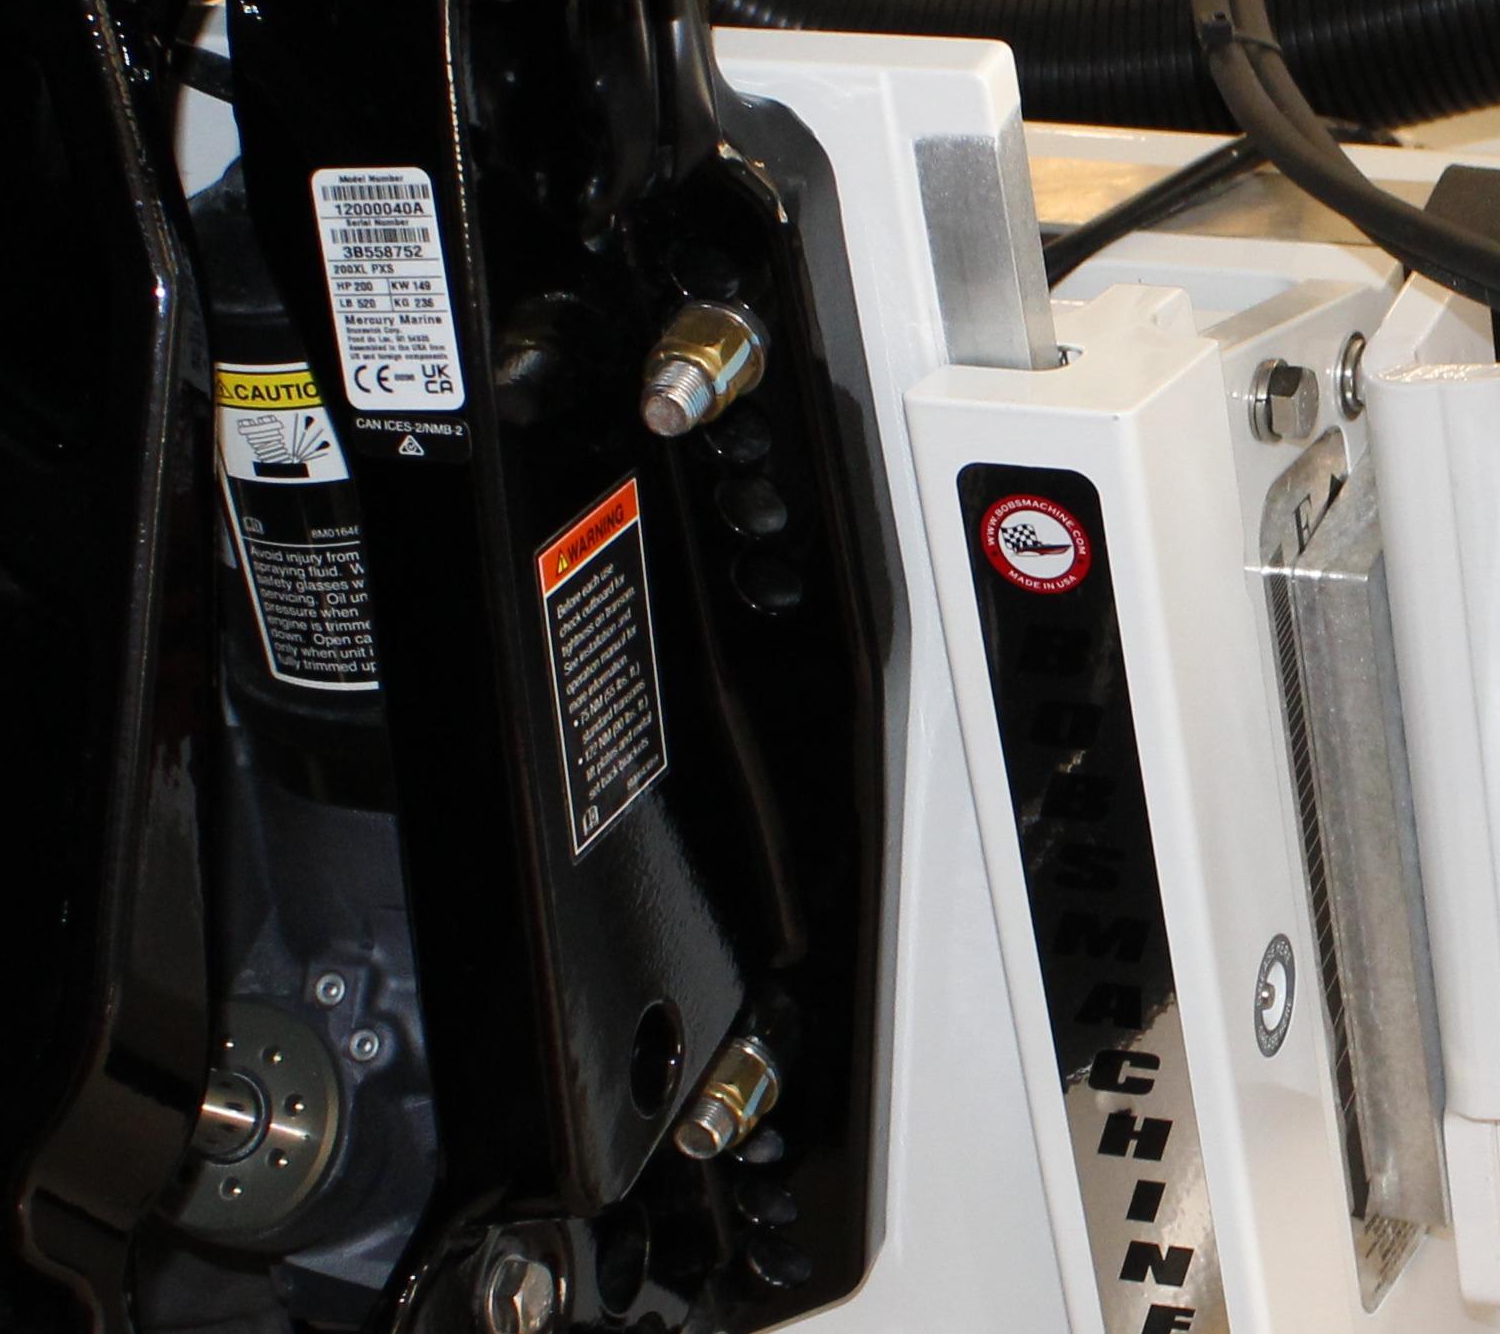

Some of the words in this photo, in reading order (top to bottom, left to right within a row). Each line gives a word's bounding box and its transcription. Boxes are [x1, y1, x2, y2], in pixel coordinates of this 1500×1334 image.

[335, 202, 424, 215] 12000040A
[346, 219, 371, 227] Serial
[343, 246, 423, 258] 3B558752
[333, 264, 366, 274] 200XL
[372, 264, 395, 274] PXS
[355, 282, 373, 291] 200
[392, 282, 409, 290] KW
[414, 281, 431, 290] 149
[340, 299, 353, 308] LB
[358, 299, 376, 308] 520
[394, 299, 409, 307] KG
[415, 298, 434, 307] 236
[345, 315, 394, 325] Mercury
[400, 315, 442, 324] Marine
[354, 365, 393, 393] CE
[422, 364, 450, 378] UK
[234, 382, 319, 401] CAUTIO
[425, 381, 454, 393] CA
[356, 418, 381, 429] CAN
[384, 421, 463, 435] ICES-2/NMB-2
[568, 504, 624, 563] WARNING
[987, 499, 1086, 555] WWW.BOBSMACHINE.COM
[251, 546, 283, 561] Avoid
[286, 553, 322, 565] injury
[327, 551, 359, 562] from
[309, 566, 342, 577] fluid.
[296, 580, 349, 592] glasses
[1008, 570, 1040, 589] MADE
[1057, 575, 1076, 588] USA
[260, 588, 318, 606] servicing.
[326, 593, 346, 604] Oil
[264, 602, 316, 617] pressure
[321, 608, 358, 617] when
[267, 616, 307, 630] engine
[311, 621, 322, 631] is
[314, 635, 351, 647] Open
[275, 643, 298, 656] only
[302, 648, 336, 657] when
[340, 647, 365, 657] unit
[303, 660, 357, 672] trimmed
